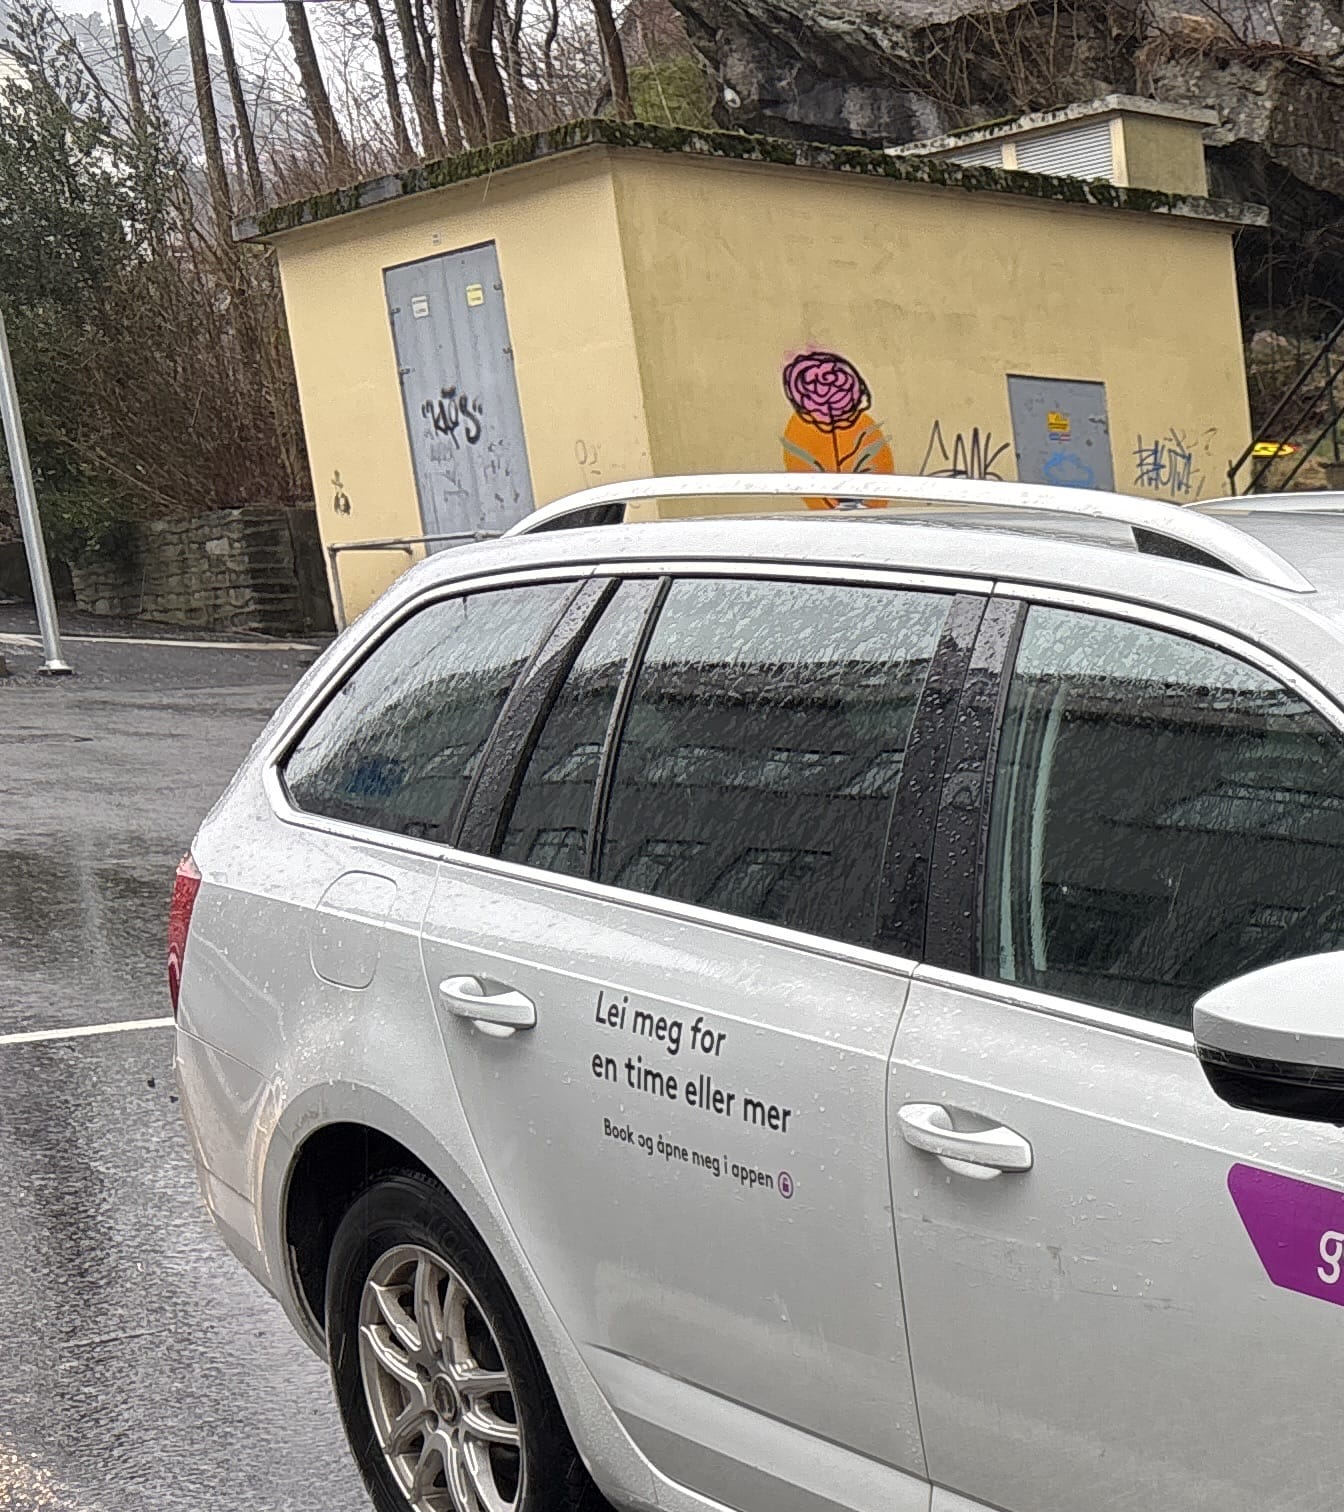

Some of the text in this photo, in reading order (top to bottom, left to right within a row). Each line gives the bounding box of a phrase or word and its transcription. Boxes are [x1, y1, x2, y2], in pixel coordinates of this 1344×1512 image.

[595, 990, 726, 1056] Lei meg for
[592, 1053, 791, 1132] en time eller mer
[603, 1117, 774, 1189] Book og åpne meg i appen
